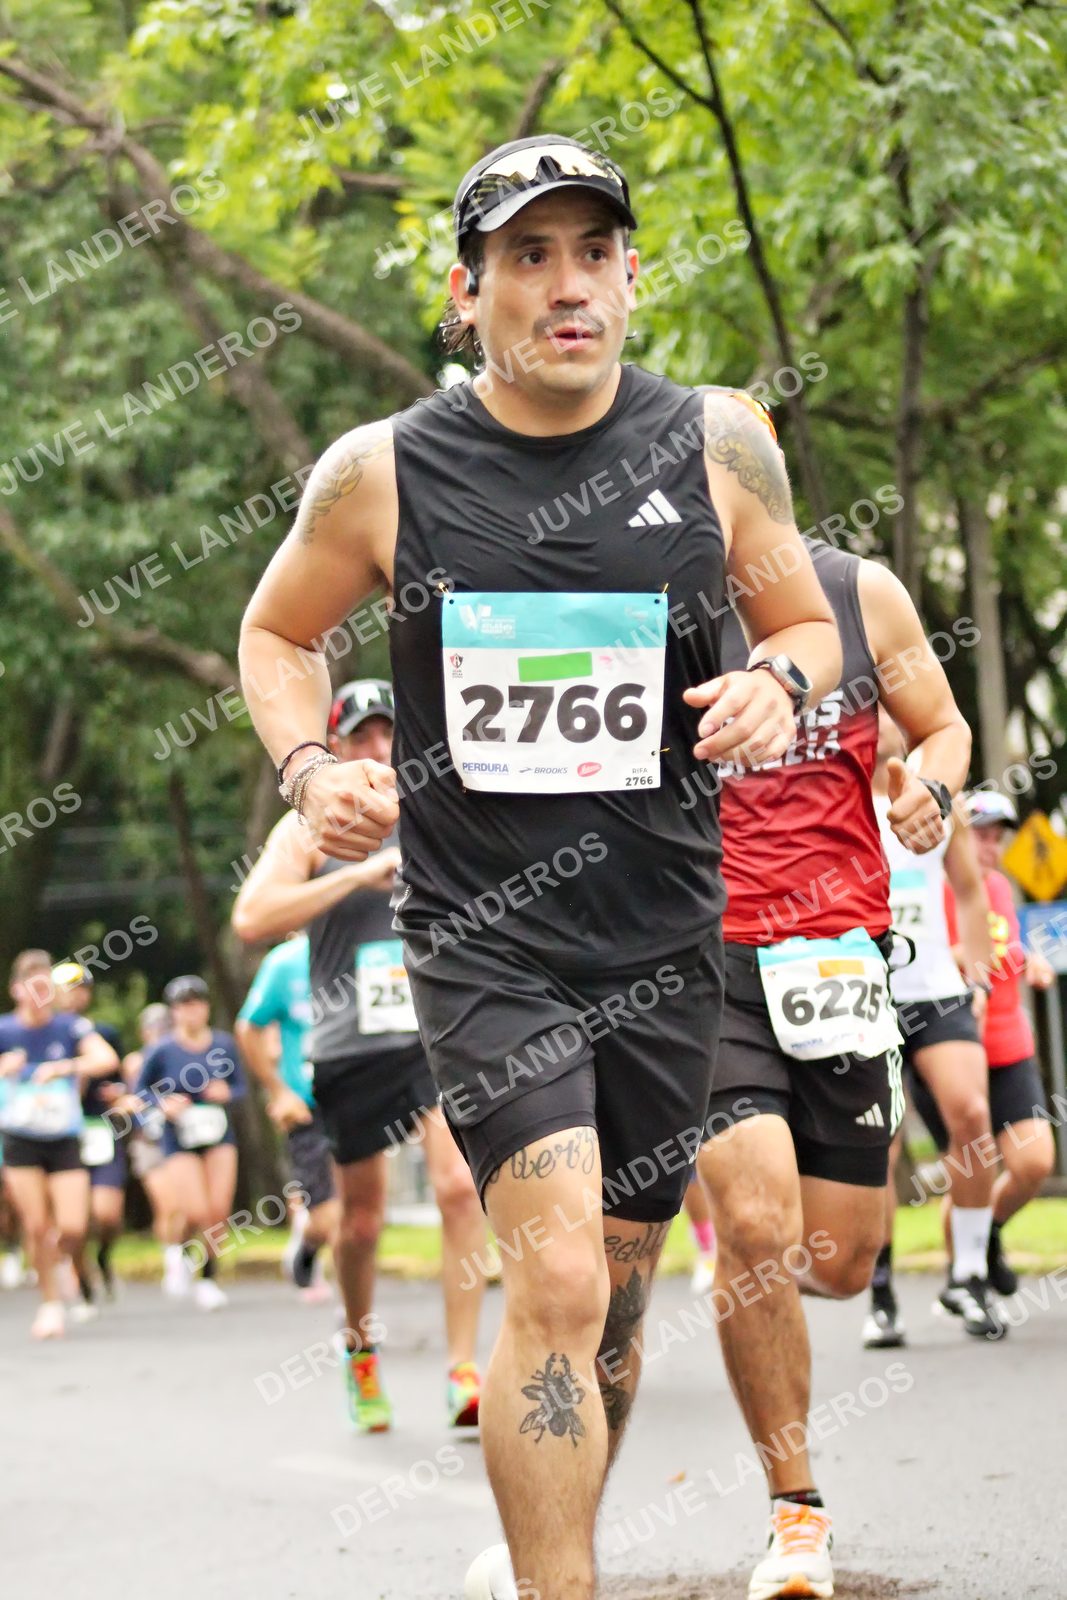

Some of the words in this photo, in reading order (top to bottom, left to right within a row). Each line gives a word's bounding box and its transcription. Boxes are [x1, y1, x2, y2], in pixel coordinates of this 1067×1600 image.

[460, 683, 648, 744] 2766
[462, 762, 509, 773] PERDURA
[534, 766, 568, 775] BROOKS
[625, 776, 654, 787] 2766
[781, 979, 883, 1026] 6225
